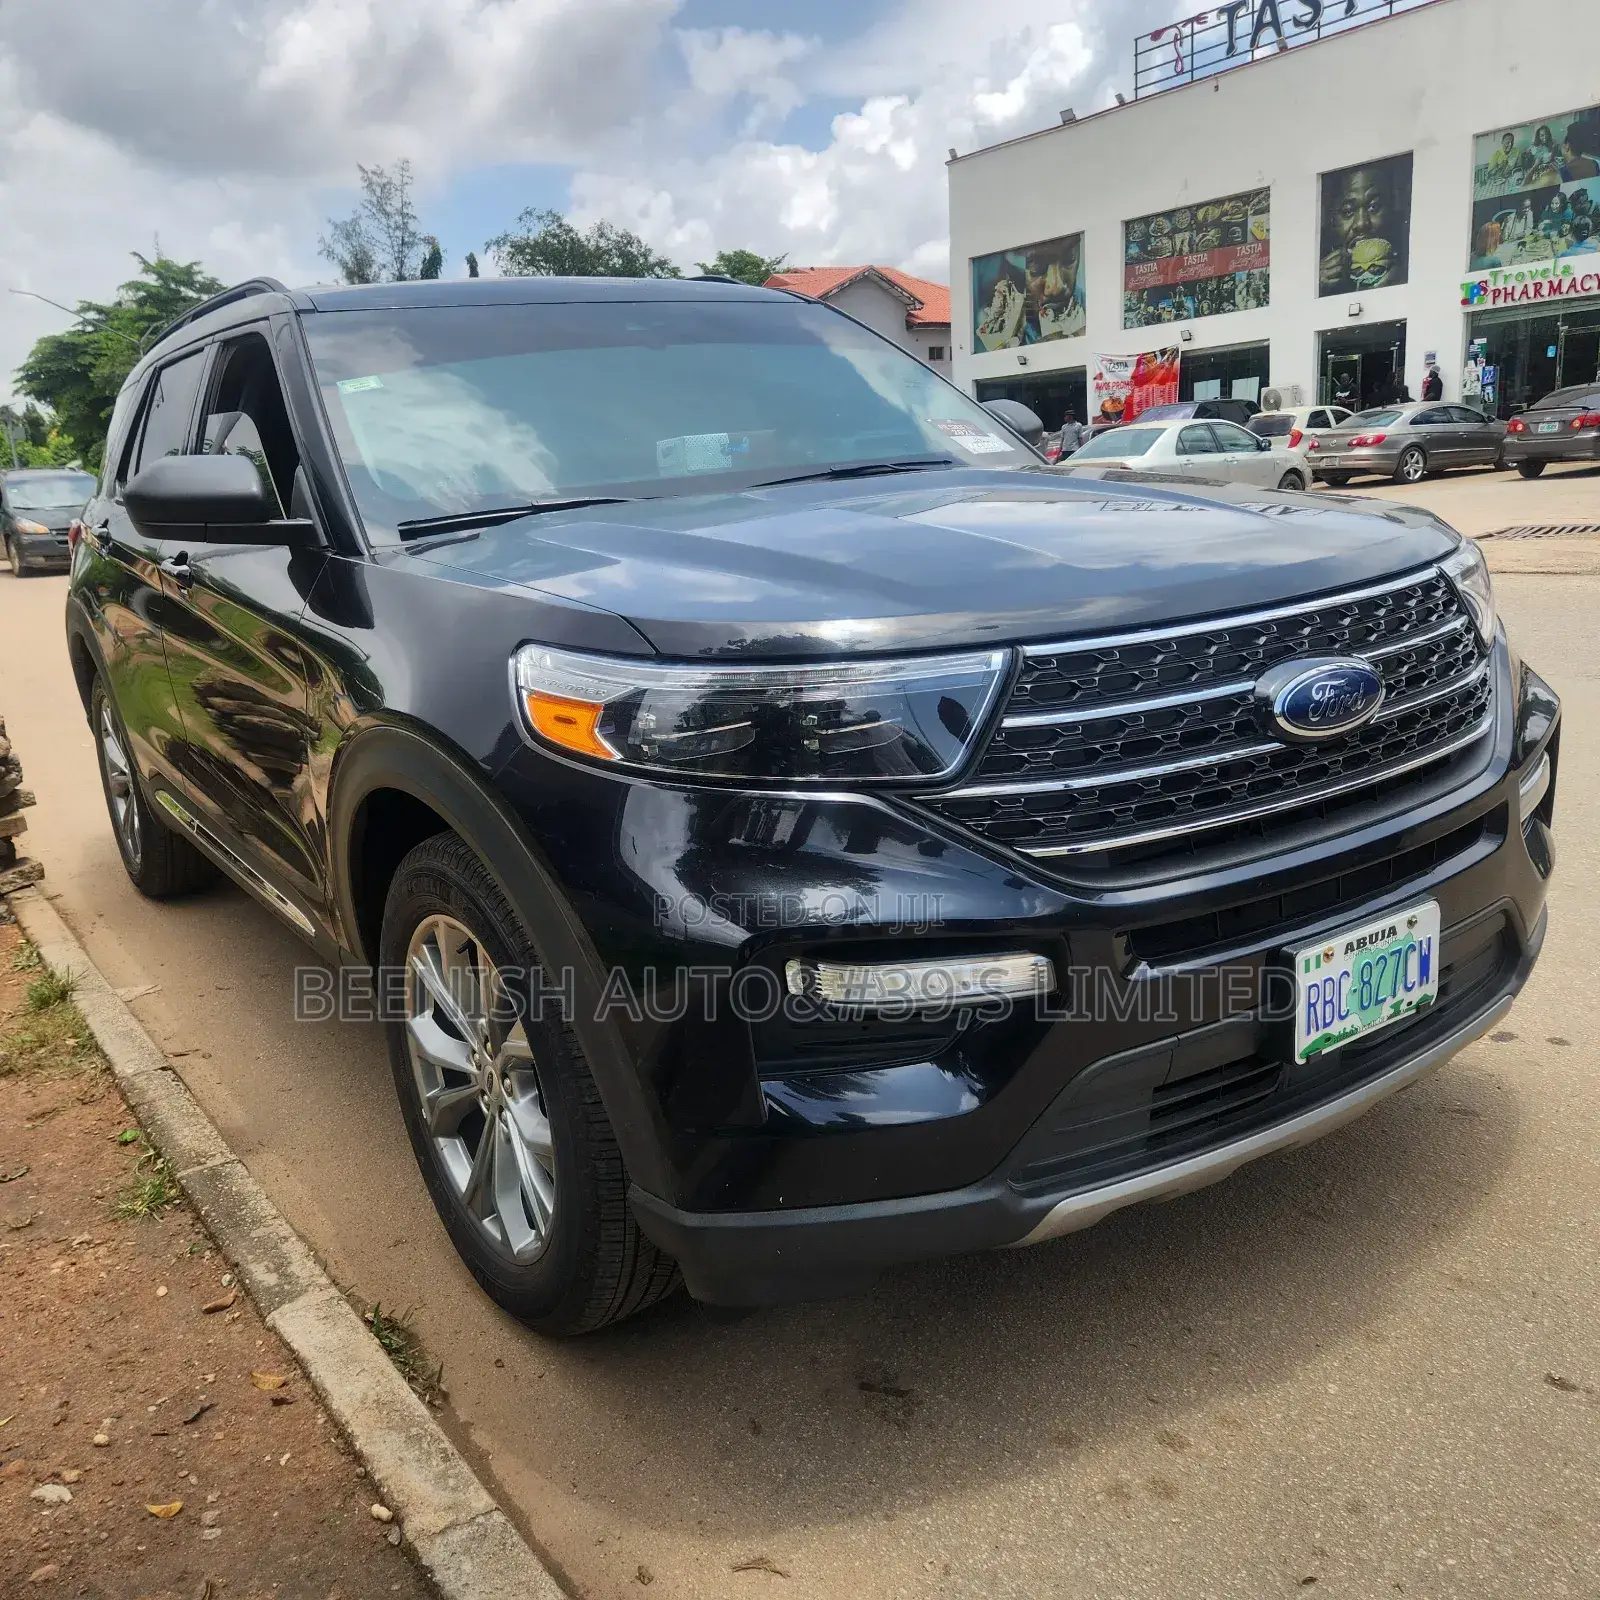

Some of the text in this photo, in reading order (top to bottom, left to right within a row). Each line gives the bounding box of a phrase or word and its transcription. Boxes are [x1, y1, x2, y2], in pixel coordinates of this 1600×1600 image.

[1217, 0, 1358, 57] TAS
[1184, 253, 1208, 266] TASTIA
[1236, 243, 1262, 257] TASTIA
[1135, 262, 1158, 275] TASTIA
[1489, 259, 1574, 286] Trovela
[536, 676, 607, 697] EXPLORER
[1308, 677, 1366, 721] Ford
[1344, 925, 1397, 955] ABUJA
[1306, 935, 1431, 1036] RBC-827CW
